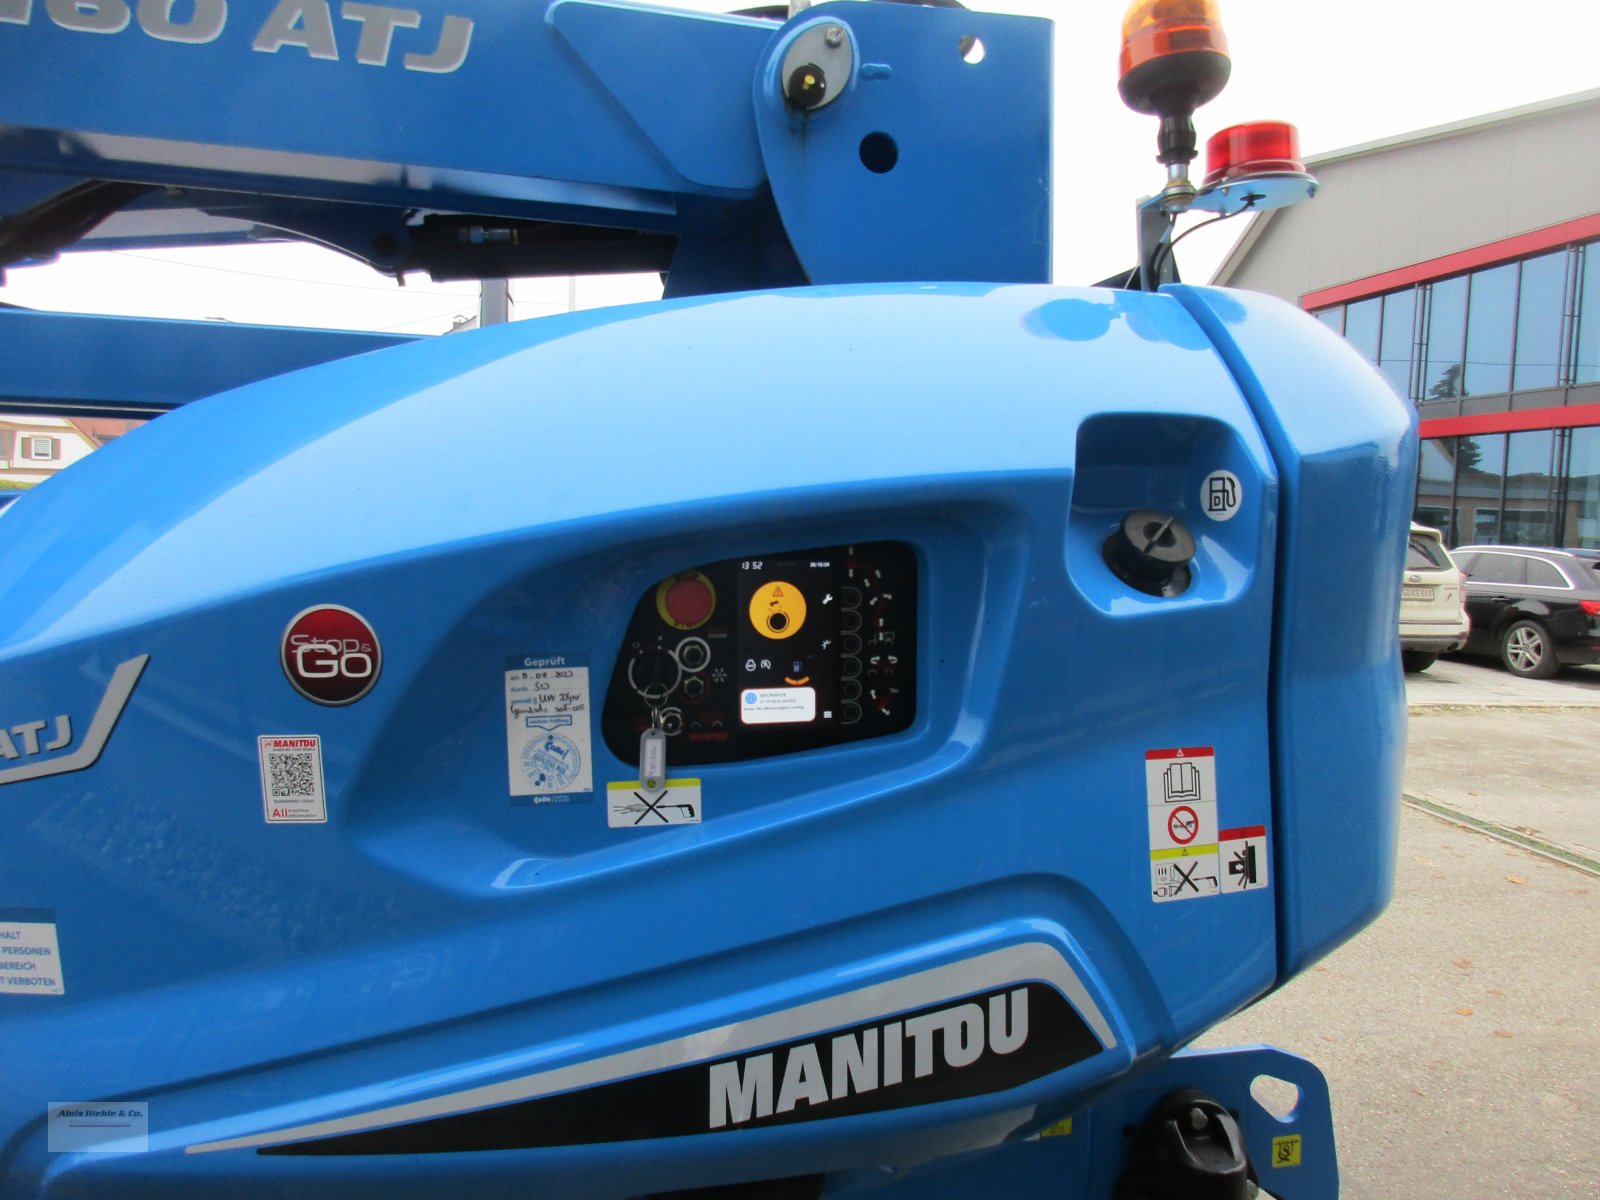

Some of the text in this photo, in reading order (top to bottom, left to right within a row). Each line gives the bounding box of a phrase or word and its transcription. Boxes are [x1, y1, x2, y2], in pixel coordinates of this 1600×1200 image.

[252, 0, 474, 74] ATJ
[291, 634, 360, 655] Stop
[297, 643, 372, 678] Go
[524, 656, 566, 668] Geprüft
[272, 808, 288, 817] All
[2, 946, 51, 955] PERSONEN
[8, 977, 56, 986] VERBOTEN
[709, 987, 1028, 1130] MANITOU
